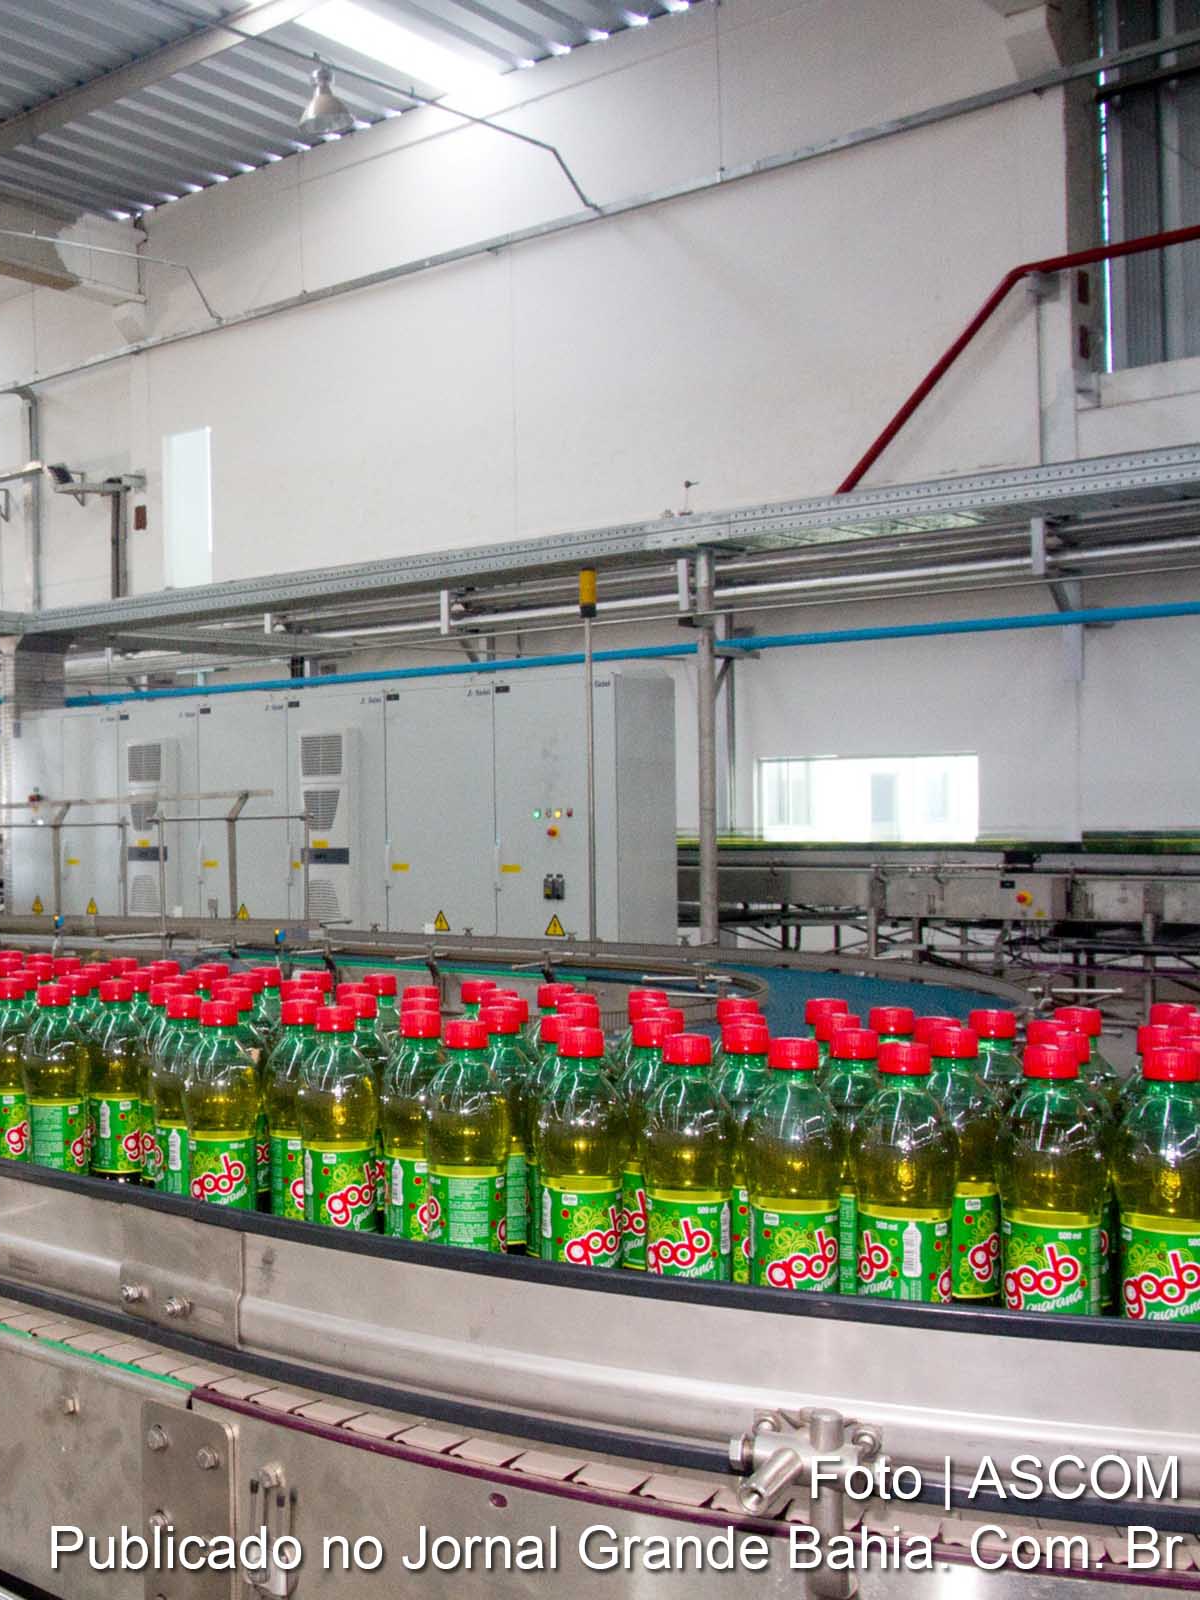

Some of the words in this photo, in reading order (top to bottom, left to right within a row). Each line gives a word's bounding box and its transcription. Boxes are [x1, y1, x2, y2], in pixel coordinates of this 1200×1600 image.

[191, 1152, 246, 1201] goob
[647, 1217, 713, 1277] goob
[766, 1228, 839, 1290] goob
[1003, 1243, 1081, 1310] goob
[1122, 1250, 1200, 1320] goob
